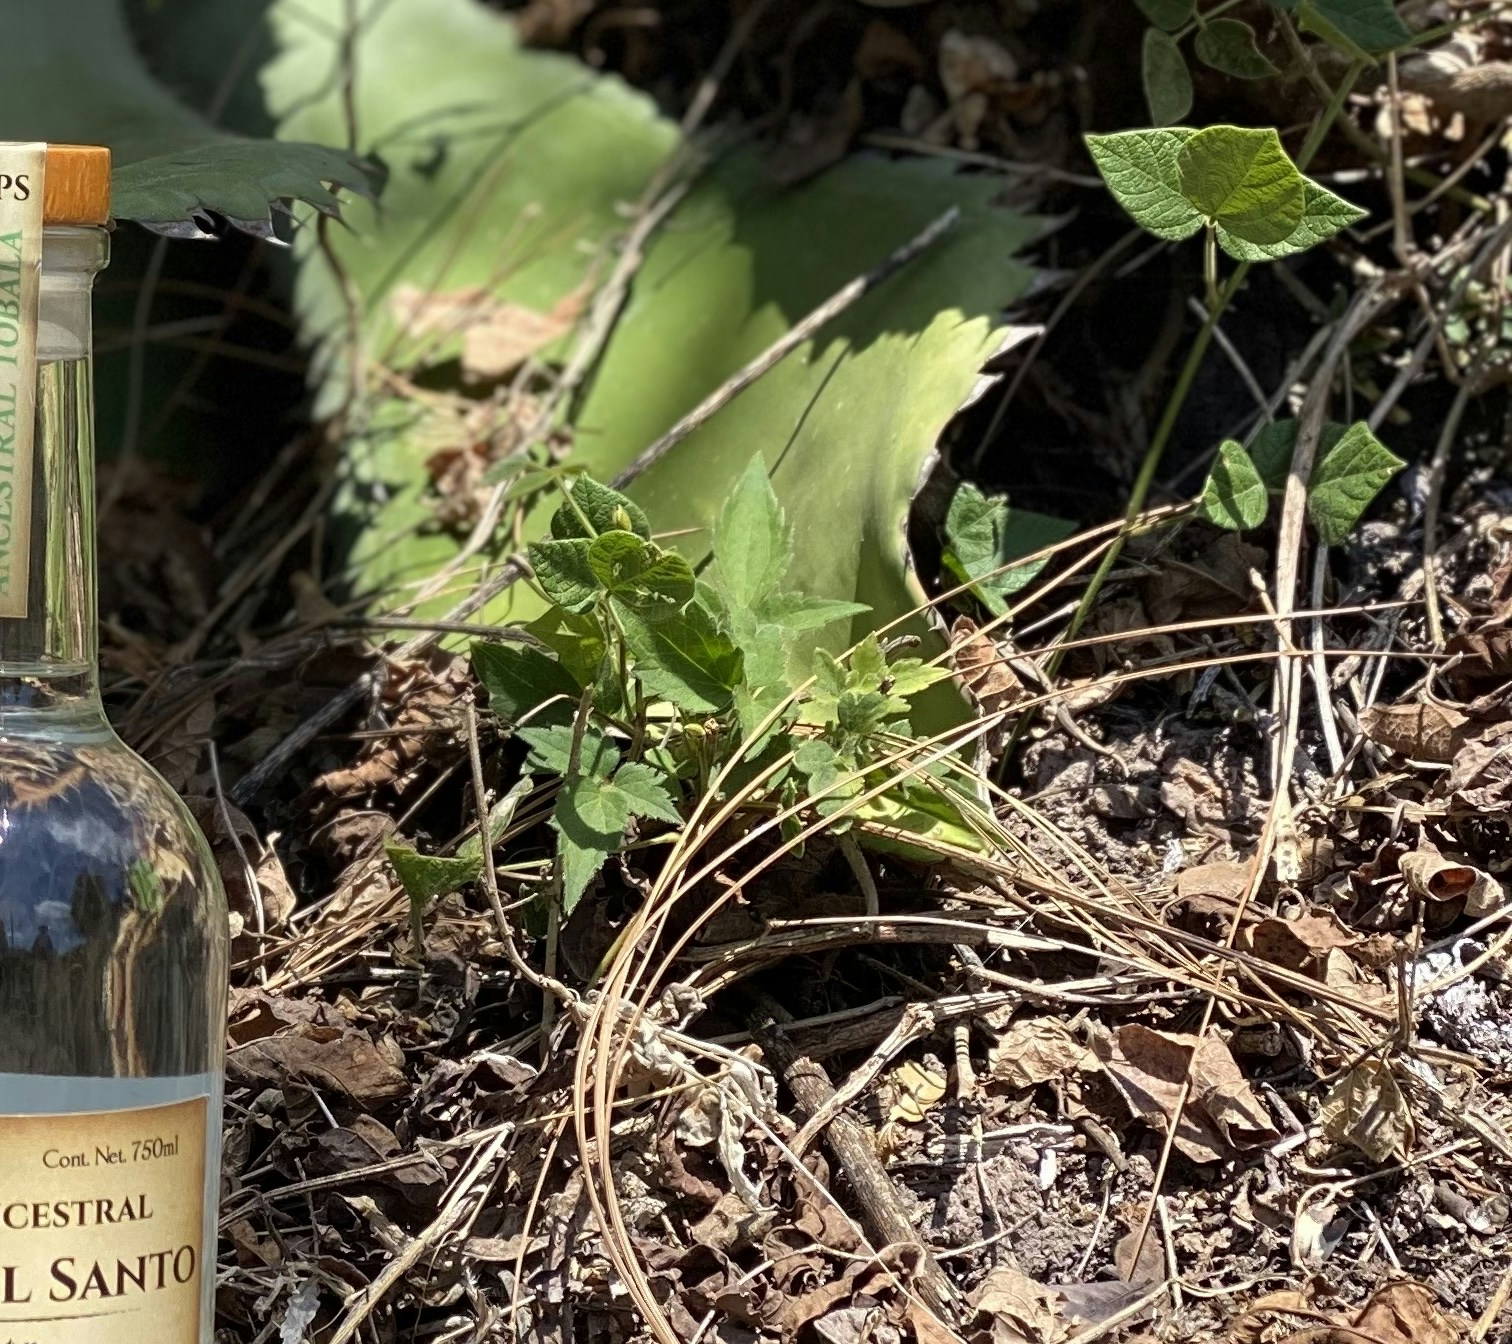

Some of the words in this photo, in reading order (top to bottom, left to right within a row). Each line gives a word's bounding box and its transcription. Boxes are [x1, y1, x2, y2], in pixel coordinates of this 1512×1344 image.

[42, 1149, 90, 1169] Cont.
[95, 1145, 126, 1167] Net.
[132, 1134, 179, 1161] 750ml
